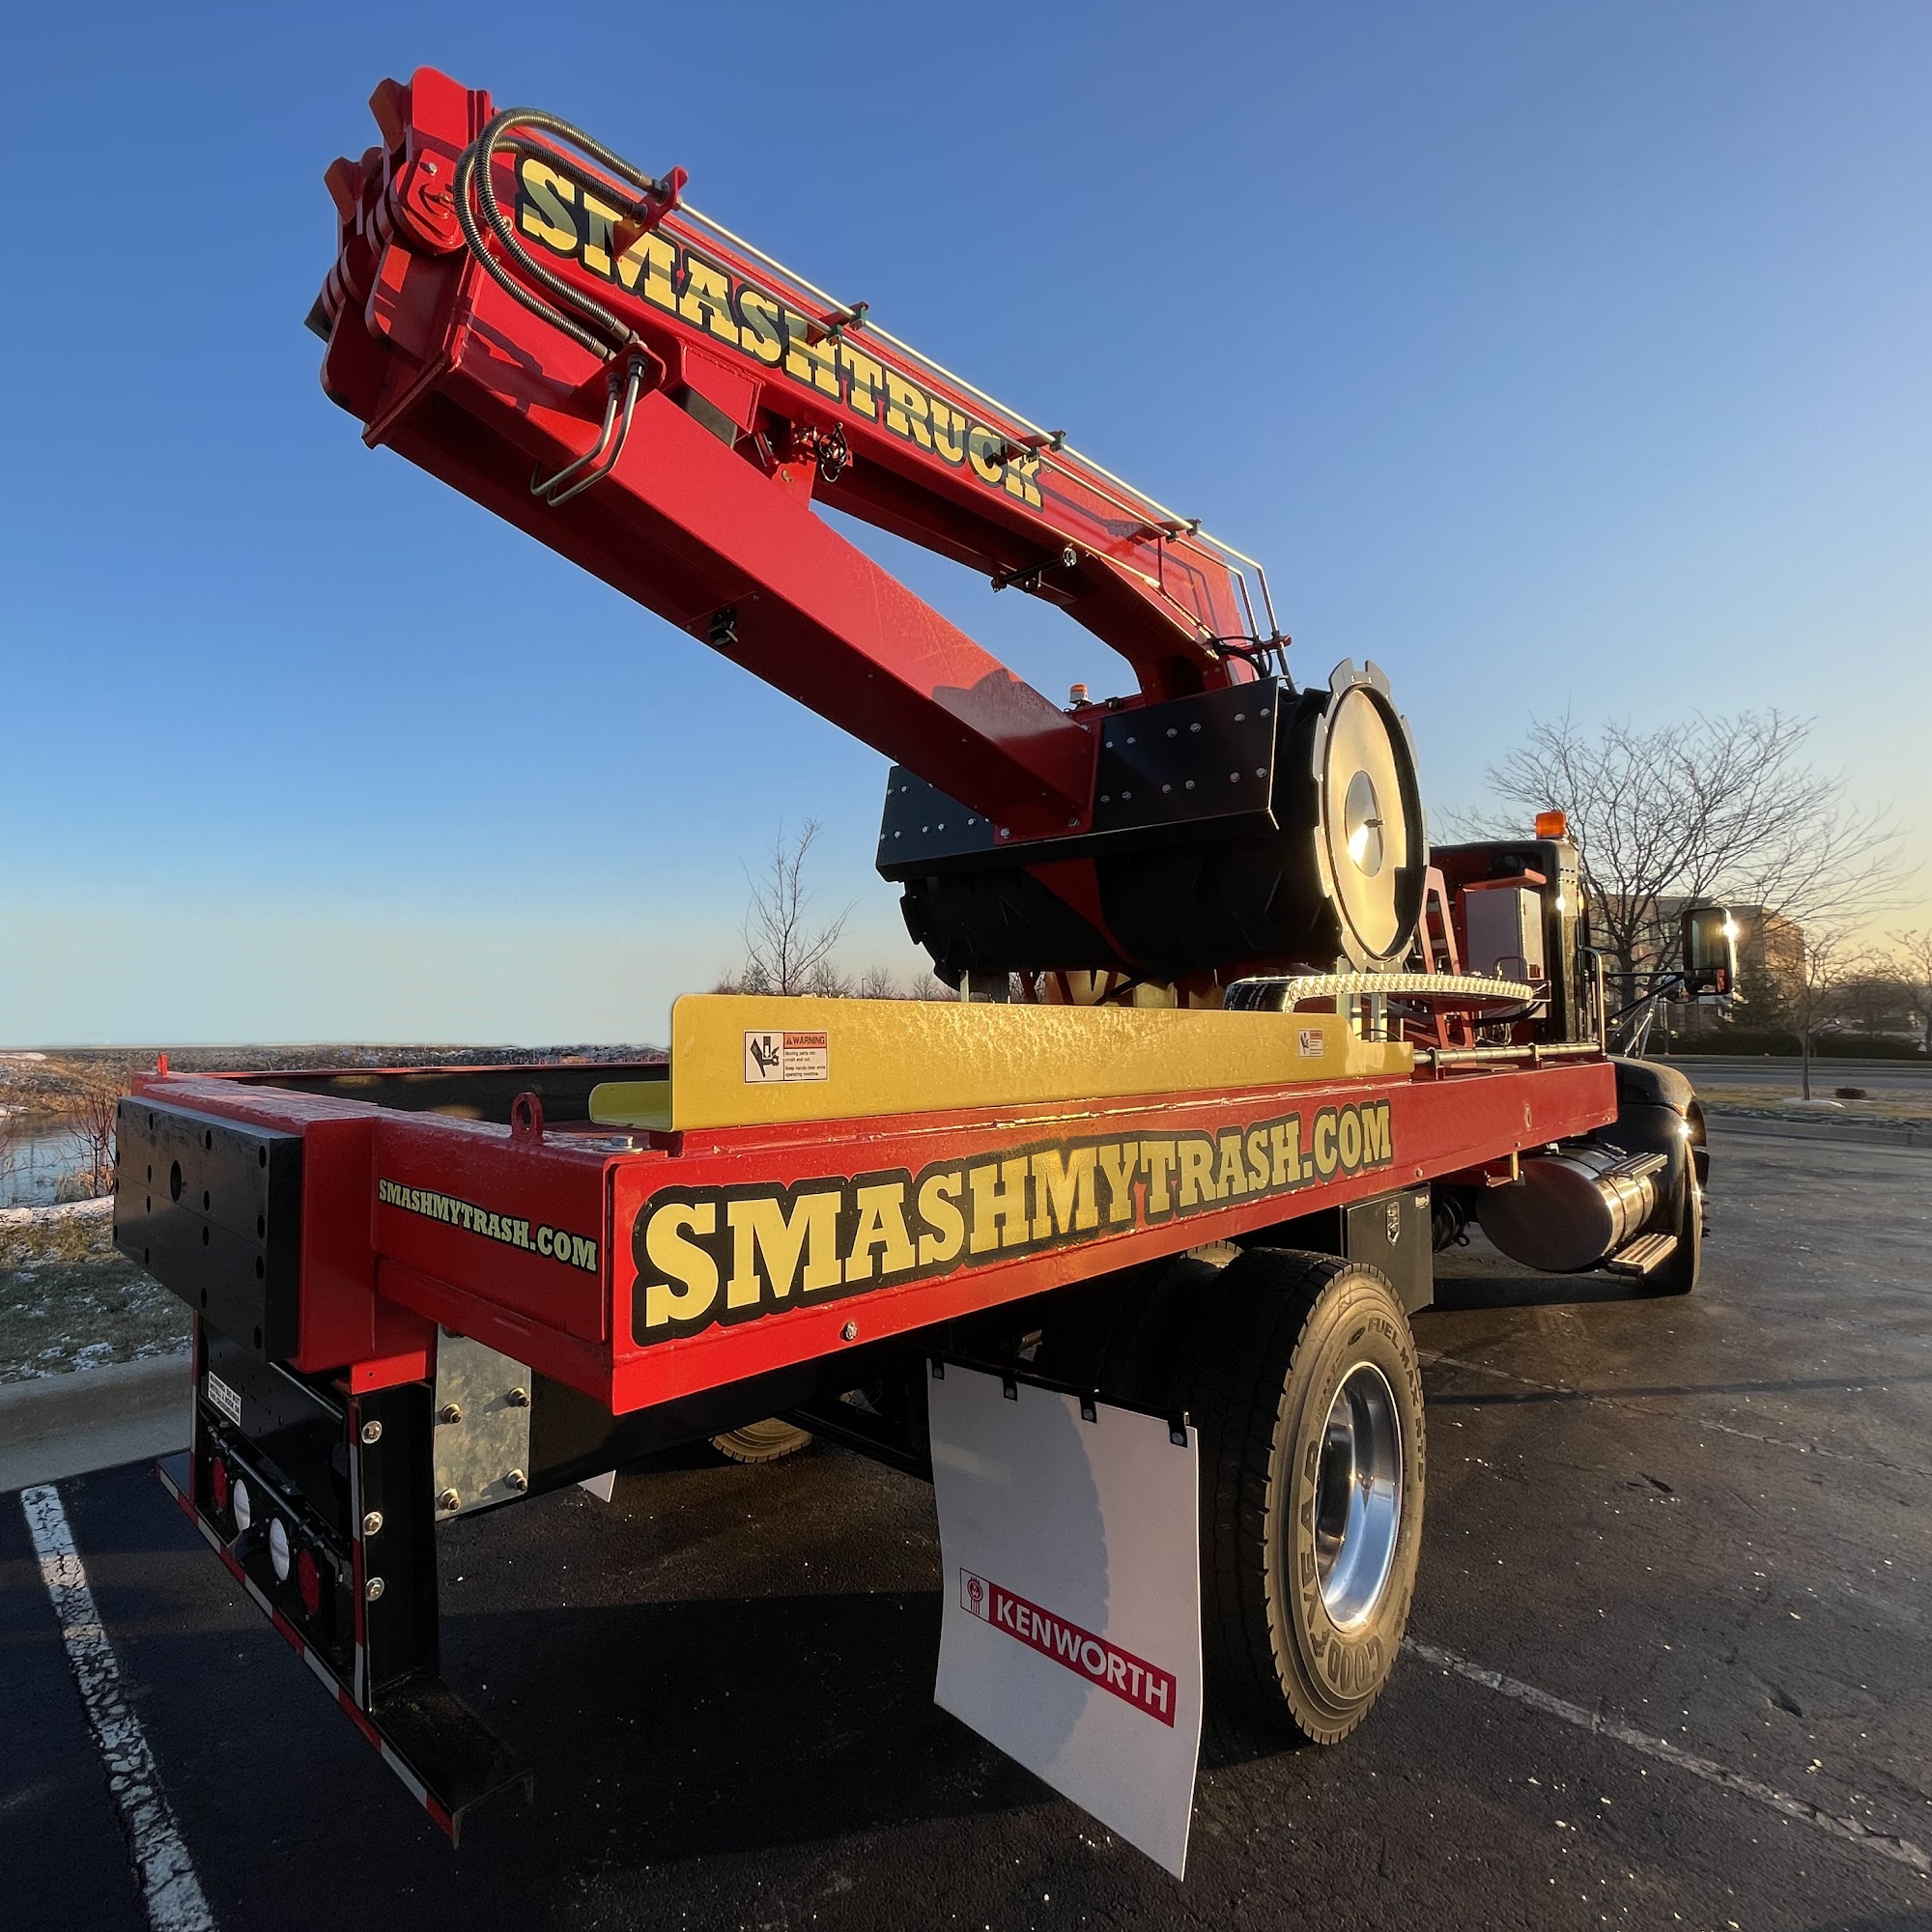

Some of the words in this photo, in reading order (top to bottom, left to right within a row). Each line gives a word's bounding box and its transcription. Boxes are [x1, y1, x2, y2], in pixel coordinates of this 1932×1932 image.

[522, 157, 1041, 508] SMASHTRUCK
[792, 1036, 825, 1044] WARNING
[379, 1179, 597, 1272] SMASHMYTRASH.COM
[646, 1099, 1392, 1329] SMASHMYTRASH.COM
[1367, 1317, 1400, 1350] FUEL
[1399, 1346, 1420, 1407] MAX
[997, 1594, 1169, 1714] KENWORTH
